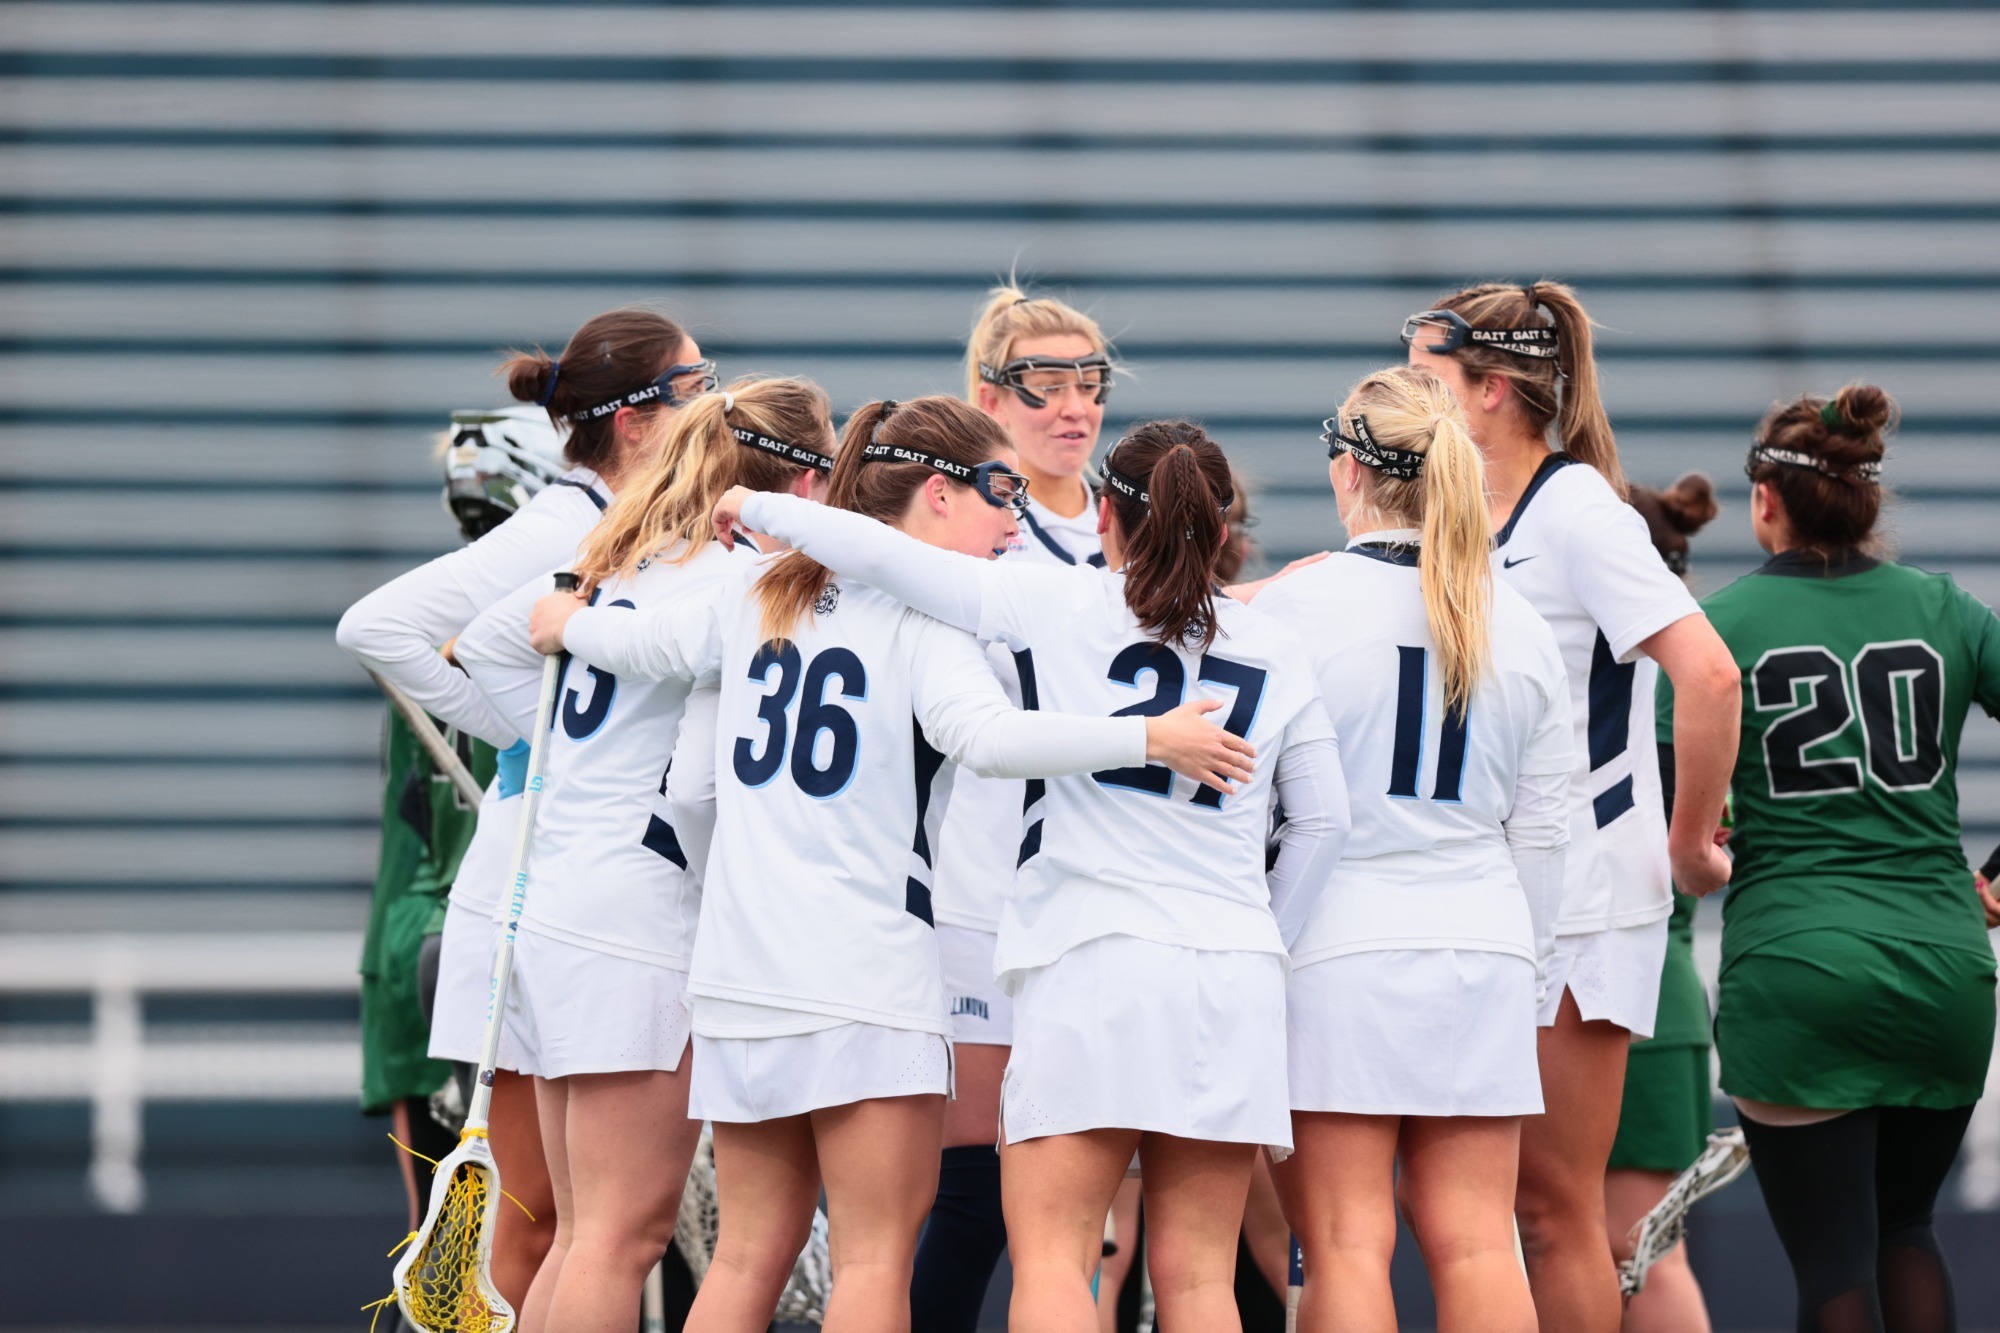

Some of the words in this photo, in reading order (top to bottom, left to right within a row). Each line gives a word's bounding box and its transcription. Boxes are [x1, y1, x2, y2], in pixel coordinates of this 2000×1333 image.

[1472, 330, 1507, 341] GAIT
[1512, 330, 1540, 341] GAIT
[592, 399, 623, 417] GAIT
[628, 385, 660, 404] GAIT
[731, 428, 754, 442] AIT
[758, 437, 789, 454] GAIT
[792, 448, 818, 464] GAIT
[893, 448, 928, 464] GAIT
[933, 458, 971, 477] GAIT
[1111, 476, 1136, 496] GAIT
[733, 637, 870, 800] 36
[1091, 641, 1270, 812] 27
[1385, 645, 1473, 804] 11
[1751, 639, 1947, 798] 20
